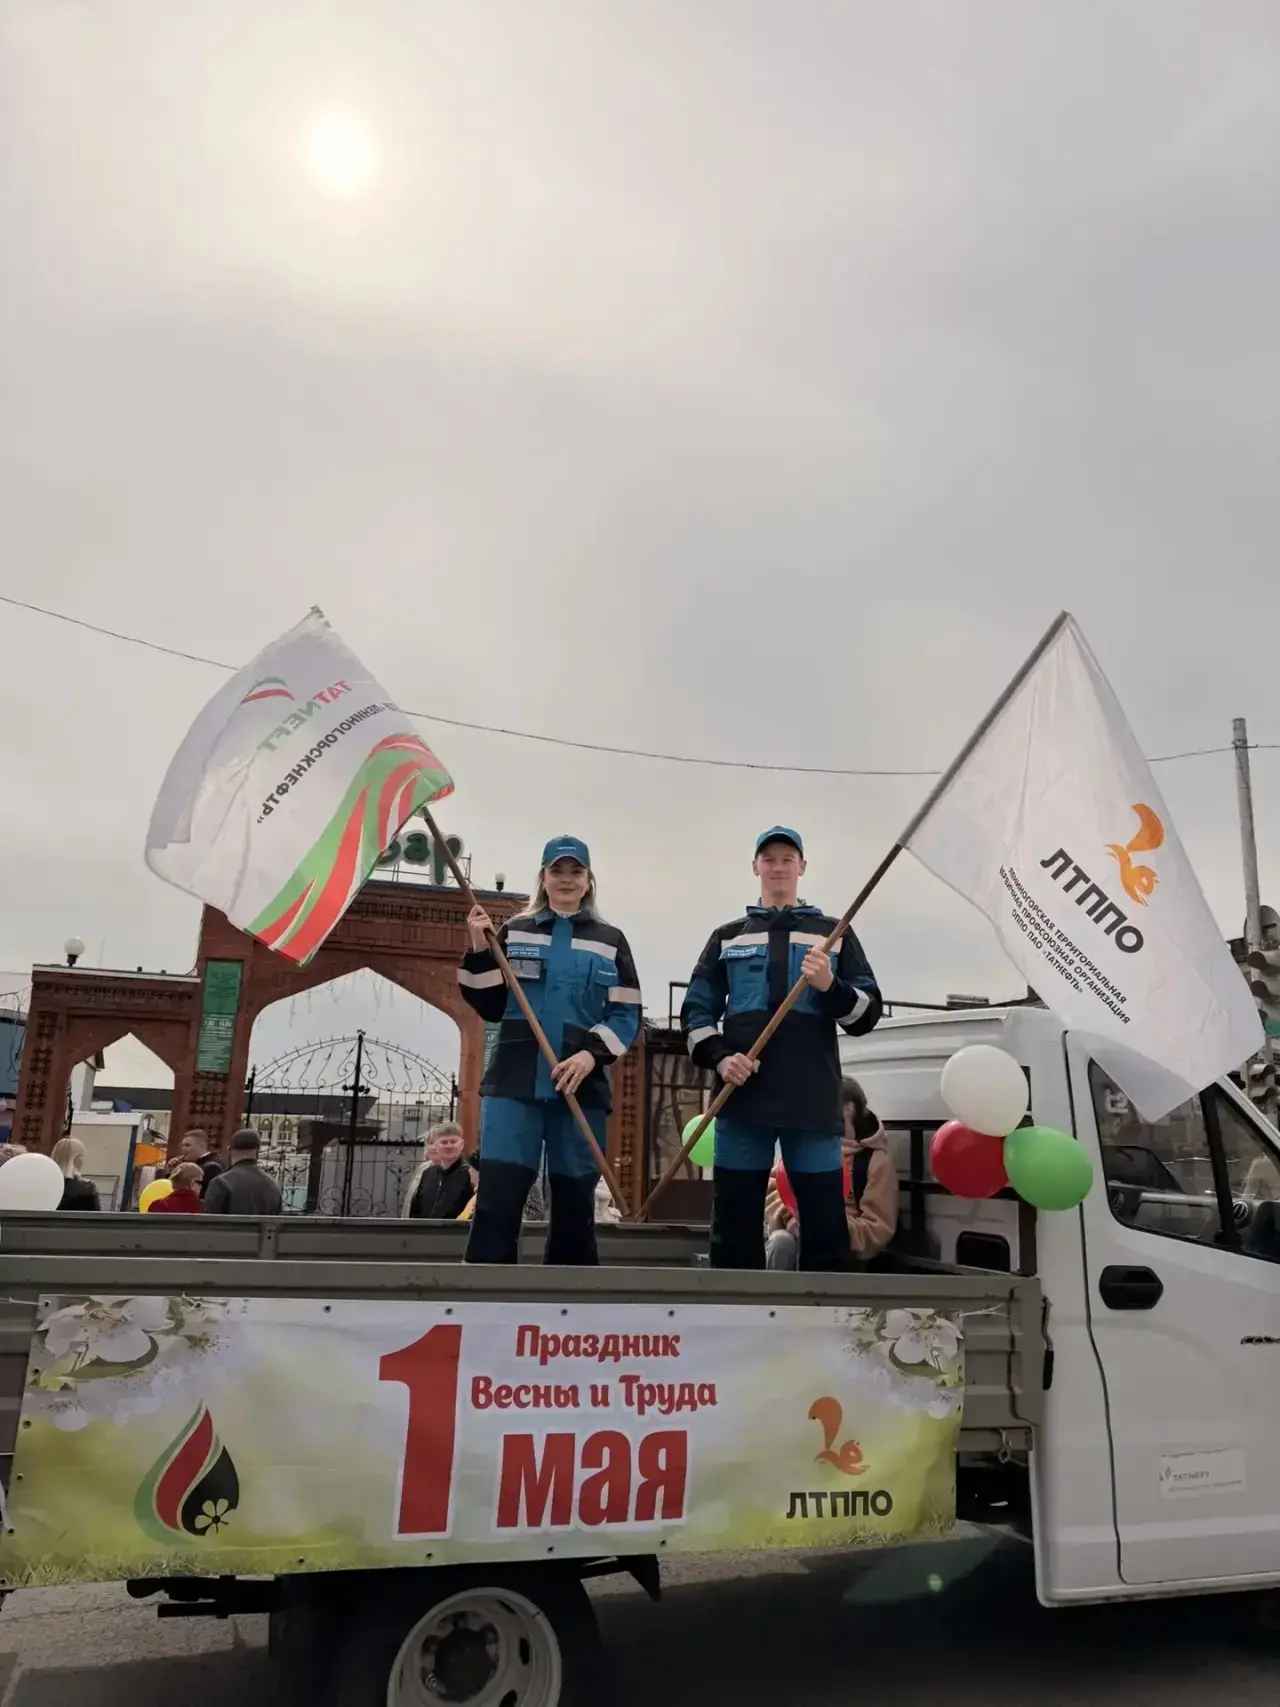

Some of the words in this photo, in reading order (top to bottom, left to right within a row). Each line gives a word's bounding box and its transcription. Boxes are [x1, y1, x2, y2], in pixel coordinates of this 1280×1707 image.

[1008, 867, 1055, 931] ЛЕНИНОГОРСКАЯ
[1055, 929, 1127, 1005] ТЕРРИТОРИАЛЬНАЯ
[1039, 848, 1144, 954] ЛТППО
[1021, 907, 1075, 968] ПРОФСОЮЗНАЯ
[1073, 959, 1131, 1025] ОРГАНИЗАЦИЯ
[1027, 931, 1043, 949] ПАО
[1042, 949, 1084, 994] «ТАТНЕФТЬ»
[515, 1324, 681, 1366] Праздник
[379, 1324, 463, 1534] 1
[496, 1430, 688, 1528] мая
[471, 1376, 580, 1410] Весны
[590, 1384, 611, 1407] и
[618, 1374, 718, 1416] Труда
[786, 1489, 893, 1519] ЛТППО
